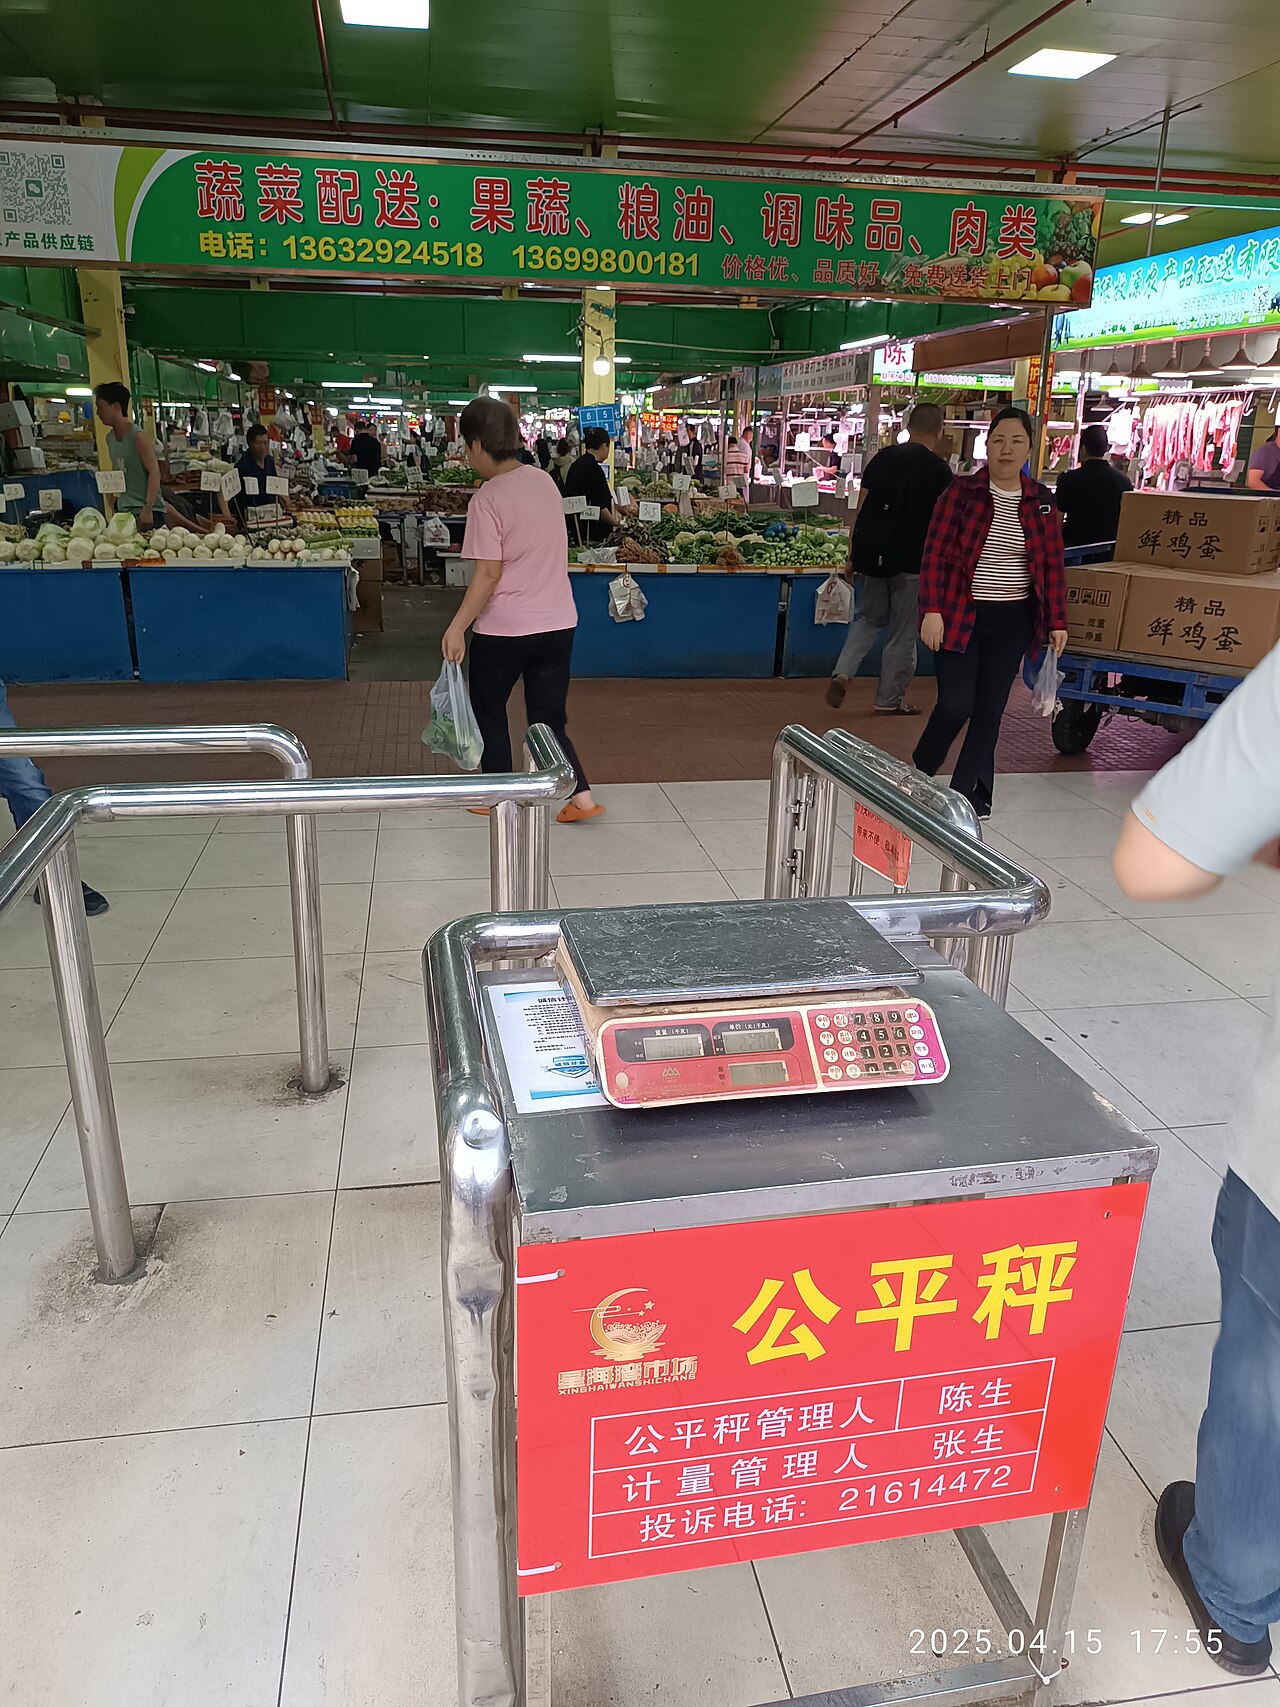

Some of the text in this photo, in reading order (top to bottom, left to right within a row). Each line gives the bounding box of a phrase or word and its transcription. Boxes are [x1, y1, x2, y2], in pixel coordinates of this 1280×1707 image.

[0, 230, 95, 252] 产品供应链
[512, 244, 699, 276] 13699800181
[883, 343, 906, 365] 陈
[586, 412, 592, 420] 6
[602, 410, 608, 419] 5
[604, 423, 609, 432] 3
[678, 478, 684, 489] 3
[45, 492, 54, 508] 3
[1161, 509, 1209, 527] 精品
[1137, 529, 1224, 560] 鲜鸡蛋
[1173, 596, 1226, 617] 精品
[1147, 616, 1243, 654] 鲜鸡蛋
[855, 1015, 862, 1024] 7
[873, 1013, 881, 1023] 8
[891, 1012, 898, 1021] 9
[860, 1033, 867, 1041] 4
[878, 1030, 885, 1039] 5
[896, 1029, 903, 1038] 6
[865, 1048, 871, 1057] 1
[882, 1047, 890, 1056] 2
[901, 1046, 908, 1055] 3
[731, 1240, 1079, 1367] 公平秤
[557, 1355, 698, 1390] 星海湾市场
[558, 1373, 697, 1396] XINGHAIWANSHICHANG
[938, 1377, 1013, 1415] 陈生
[623, 1395, 876, 1457] 公平秤管理人
[621, 1423, 1005, 1504] 计量管理人 张生
[838, 1464, 1013, 1512] 21614472
